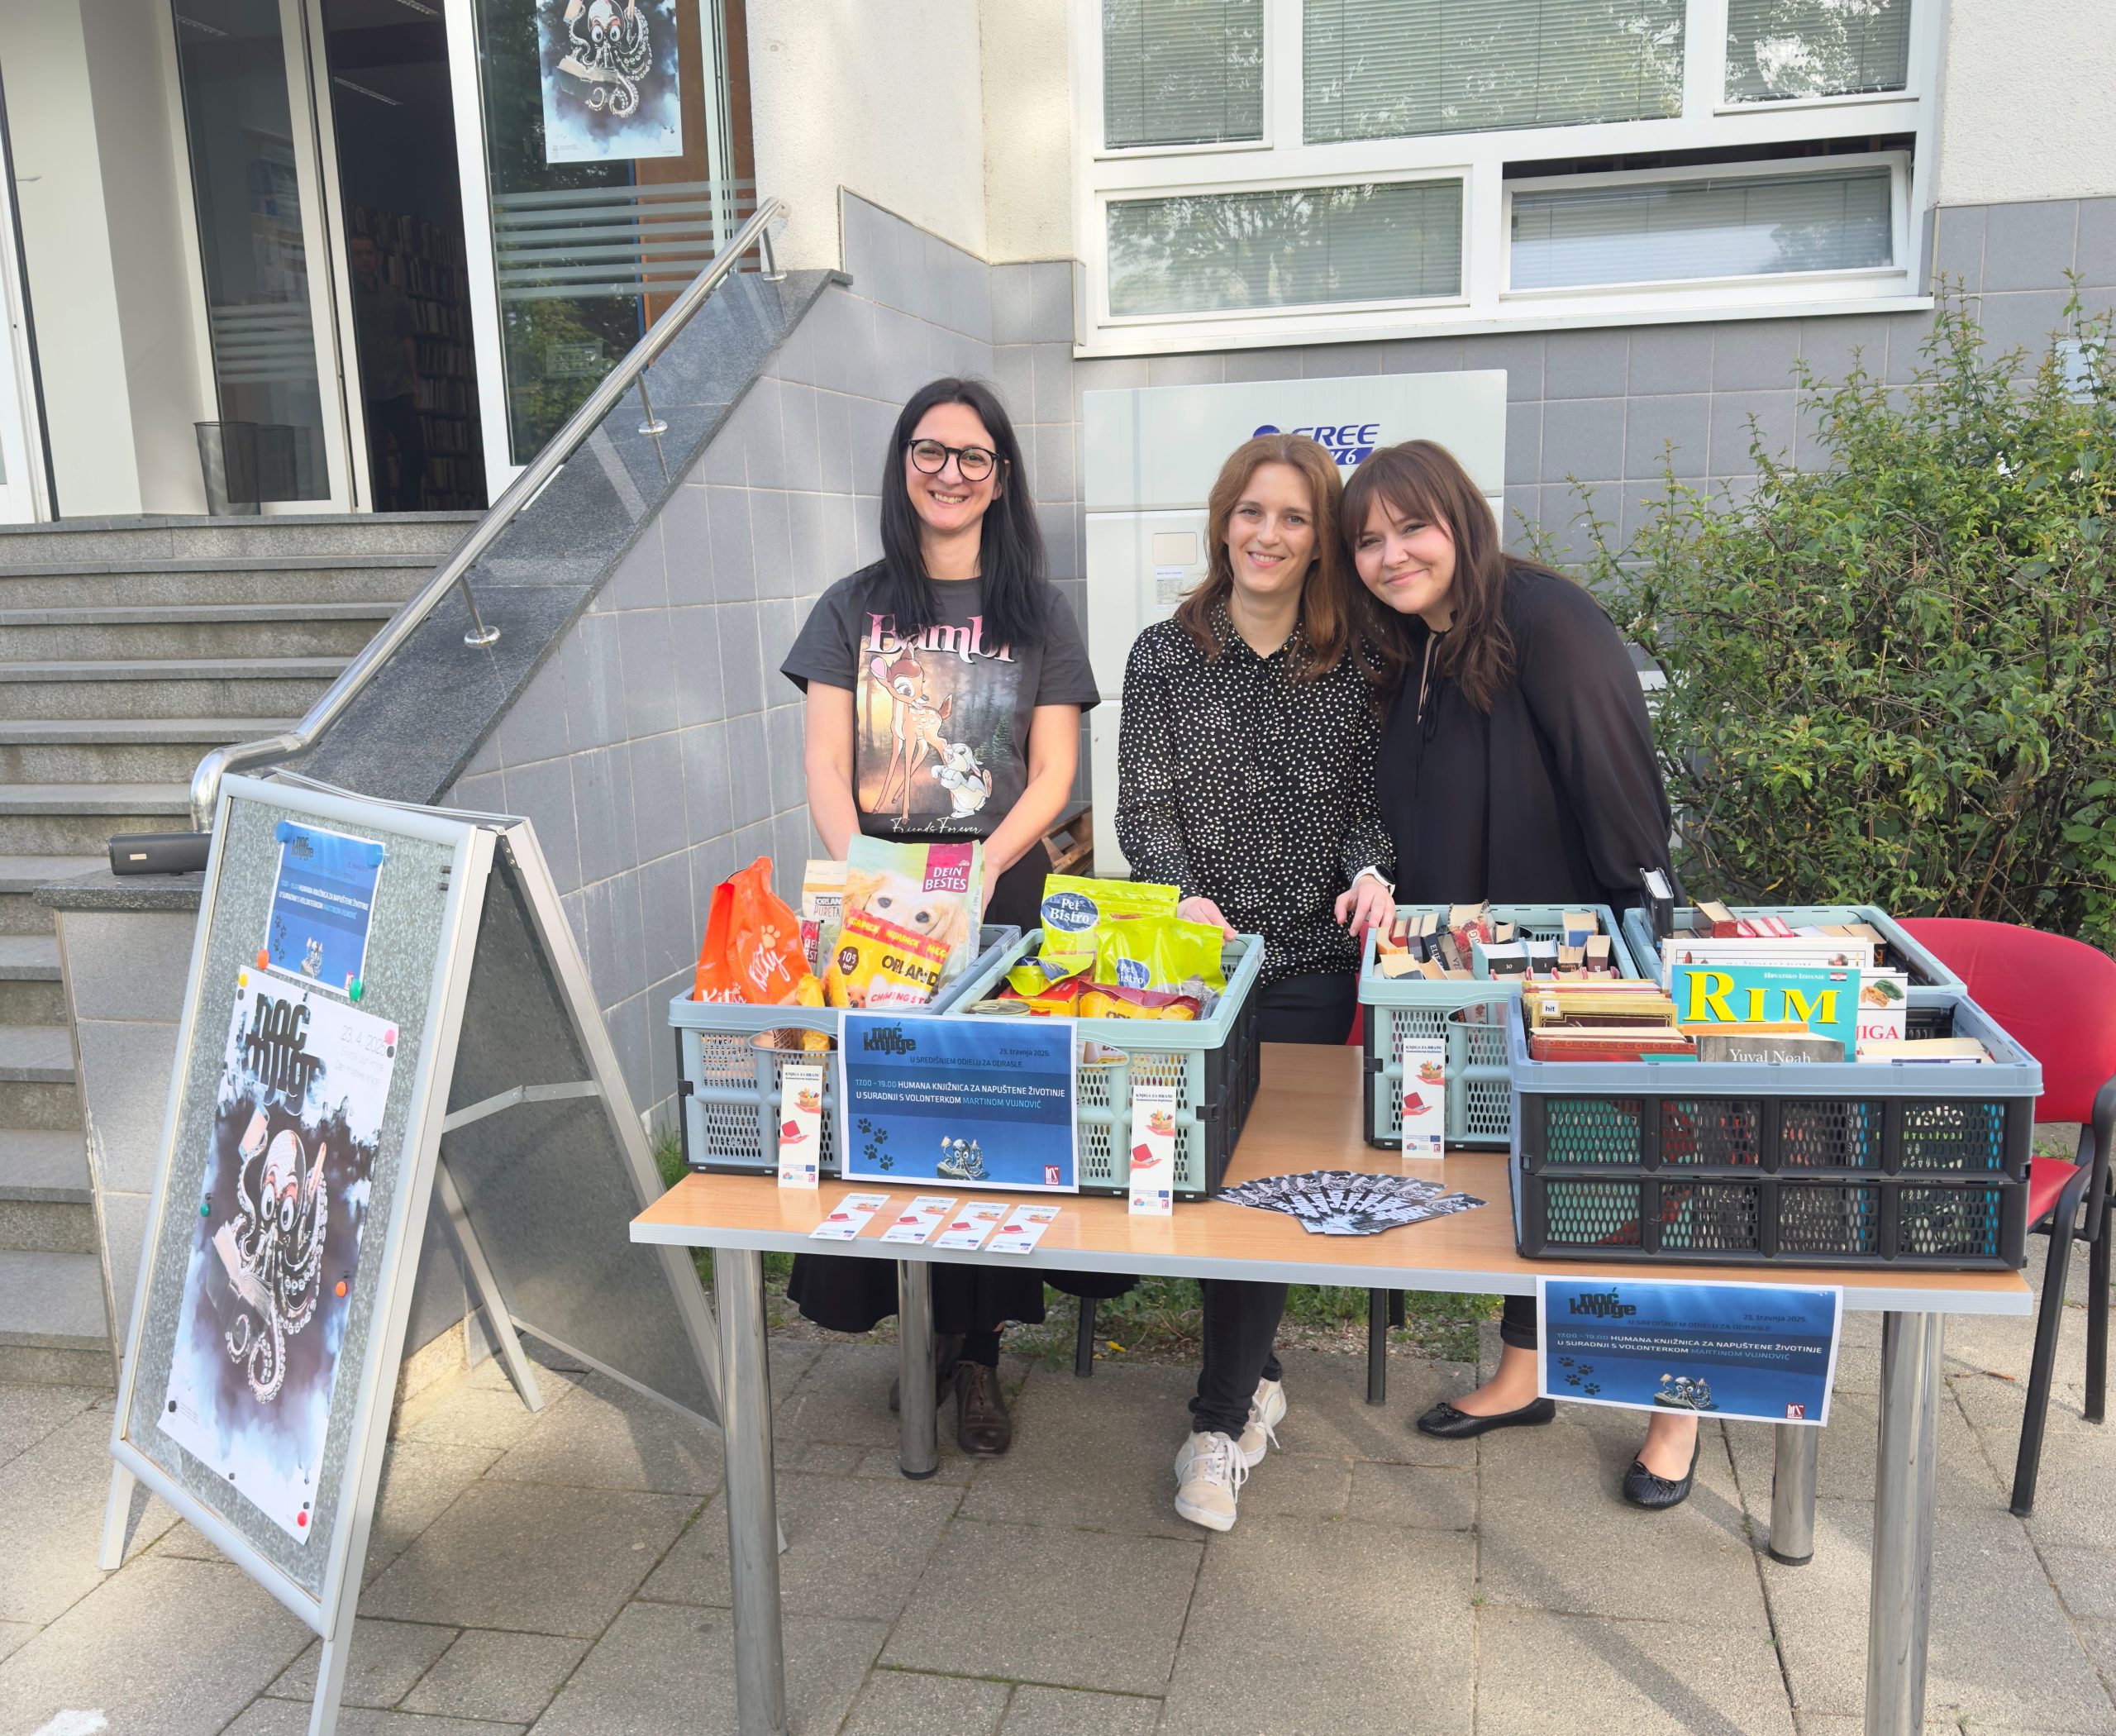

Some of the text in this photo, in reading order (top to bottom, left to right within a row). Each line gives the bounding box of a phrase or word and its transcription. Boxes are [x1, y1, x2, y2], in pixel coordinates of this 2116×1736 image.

[936, 816, 982, 834] Forever
[933, 866, 963, 878] DEIN
[925, 877, 967, 890] BESTES
[1061, 898, 1079, 911] Pet
[1050, 908, 1089, 924] Bistro
[1121, 963, 1135, 975] Pet
[1683, 971, 1842, 1024] RIM
[872, 1022, 903, 1040] noć
[863, 1032, 917, 1055] knjige
[1009, 1048, 1032, 1057] travnja
[1033, 1049, 1051, 1057] 2025.
[916, 1056, 956, 1065] SREDIŠNJEM
[992, 1060, 1022, 1068] ODRASLE
[1729, 1048, 1811, 1064] Yuval Noah
[878, 1080, 896, 1088] 19.00
[898, 1080, 931, 1090] HUMANA
[932, 1081, 969, 1092] KNJIŽNICA
[970, 1084, 980, 1092] ZA
[981, 1085, 1027, 1095] NAPUŠTENE
[1028, 1085, 1065, 1098] ŽIVOTINJE
[863, 1091, 898, 1101] SURADNJI
[898, 1093, 904, 1101] S
[905, 1094, 961, 1104] VOLONTERKOM
[962, 1097, 1003, 1106] MARTINOM
[1005, 1099, 1041, 1109] VUJNOVIĆ
[1580, 1287, 1619, 1305] noć
[1569, 1298, 1637, 1319] knjige
[1756, 1314, 1785, 1323] travnja
[1566, 1340, 1609, 1348] SURADNJI
[1618, 1343, 1689, 1353] VOLONTERKOM
[1690, 1347, 1742, 1357] MARTINOM
[1745, 1351, 1790, 1361] VUJNOVIĆ
[1610, 1335, 1652, 1343] HUMANA
[1654, 1337, 1699, 1347] KNJIŽNICA
[1716, 1341, 1773, 1351] NAPUŠTENE
[1775, 1343, 1823, 1354] ŽIVOTINJE
